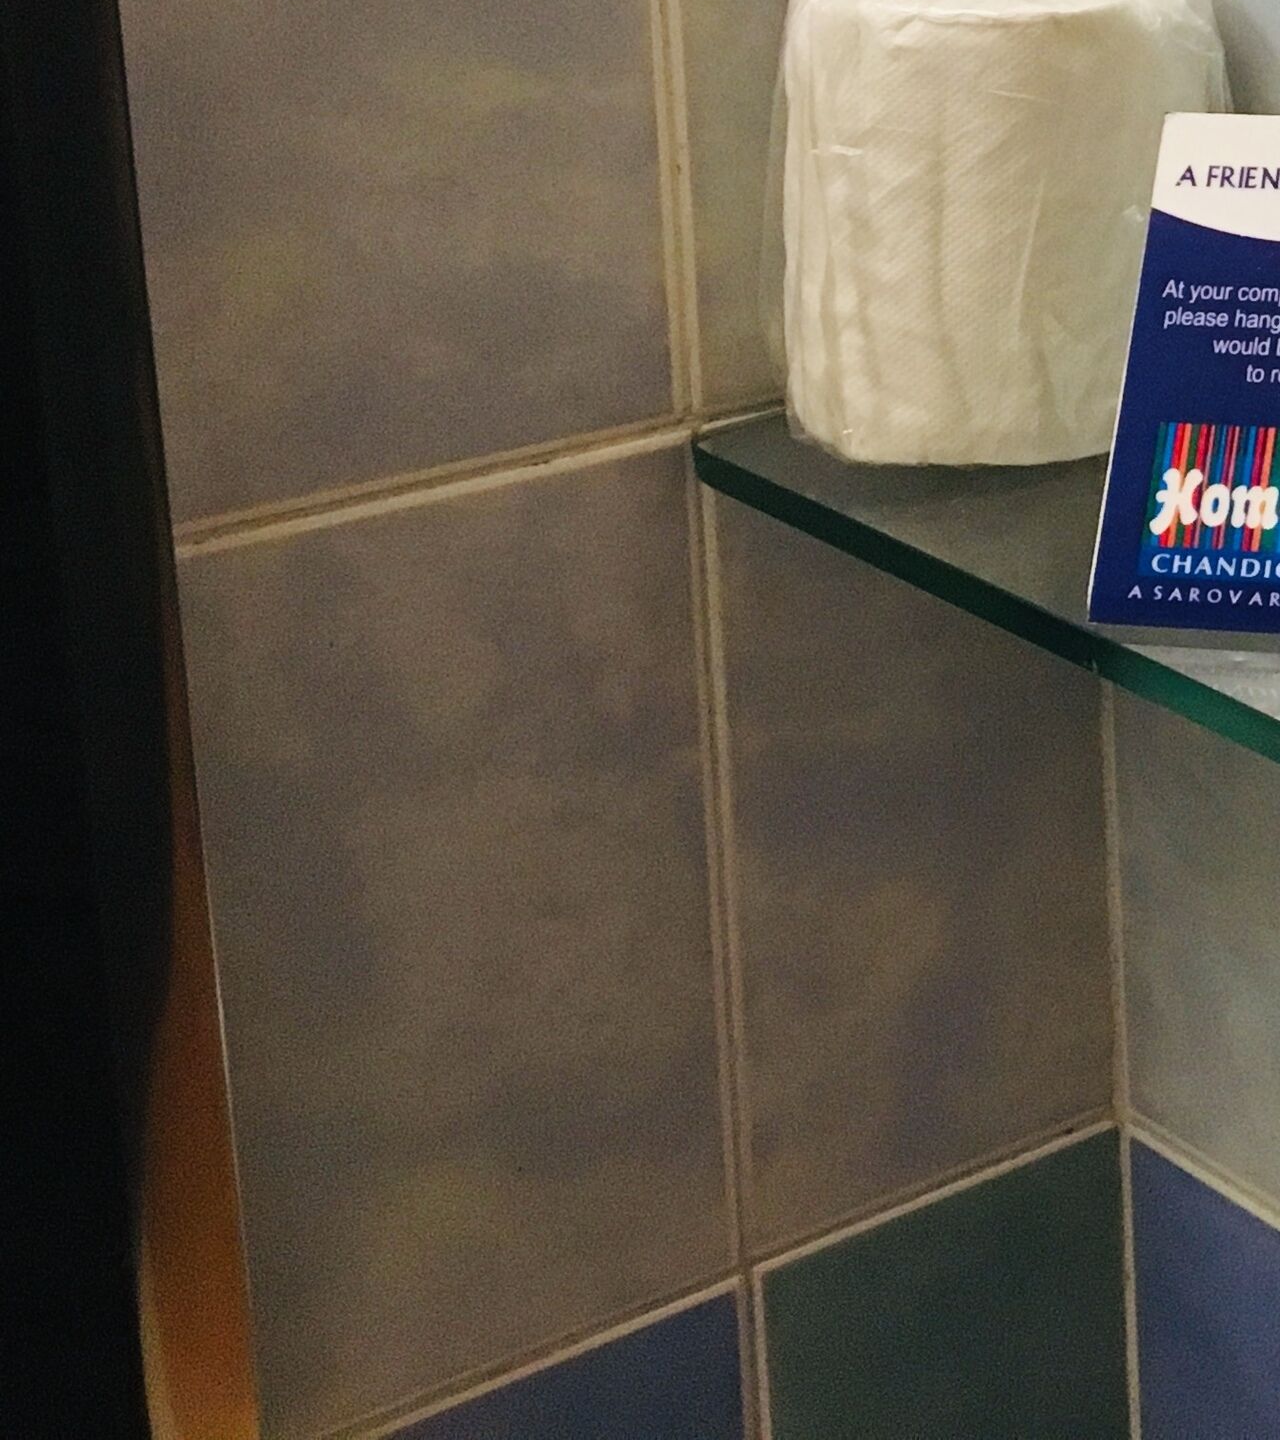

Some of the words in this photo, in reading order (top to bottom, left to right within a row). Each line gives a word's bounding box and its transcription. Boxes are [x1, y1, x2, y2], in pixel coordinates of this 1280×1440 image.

[1175, 166, 1196, 187] A
[1162, 279, 1184, 298] At
[1189, 282, 1233, 304] your
[1163, 309, 1229, 328] please
[1213, 337, 1270, 355] would
[1246, 365, 1264, 382] to
[1128, 585, 1142, 599] A
[1154, 586, 1280, 607] SAROVAR
